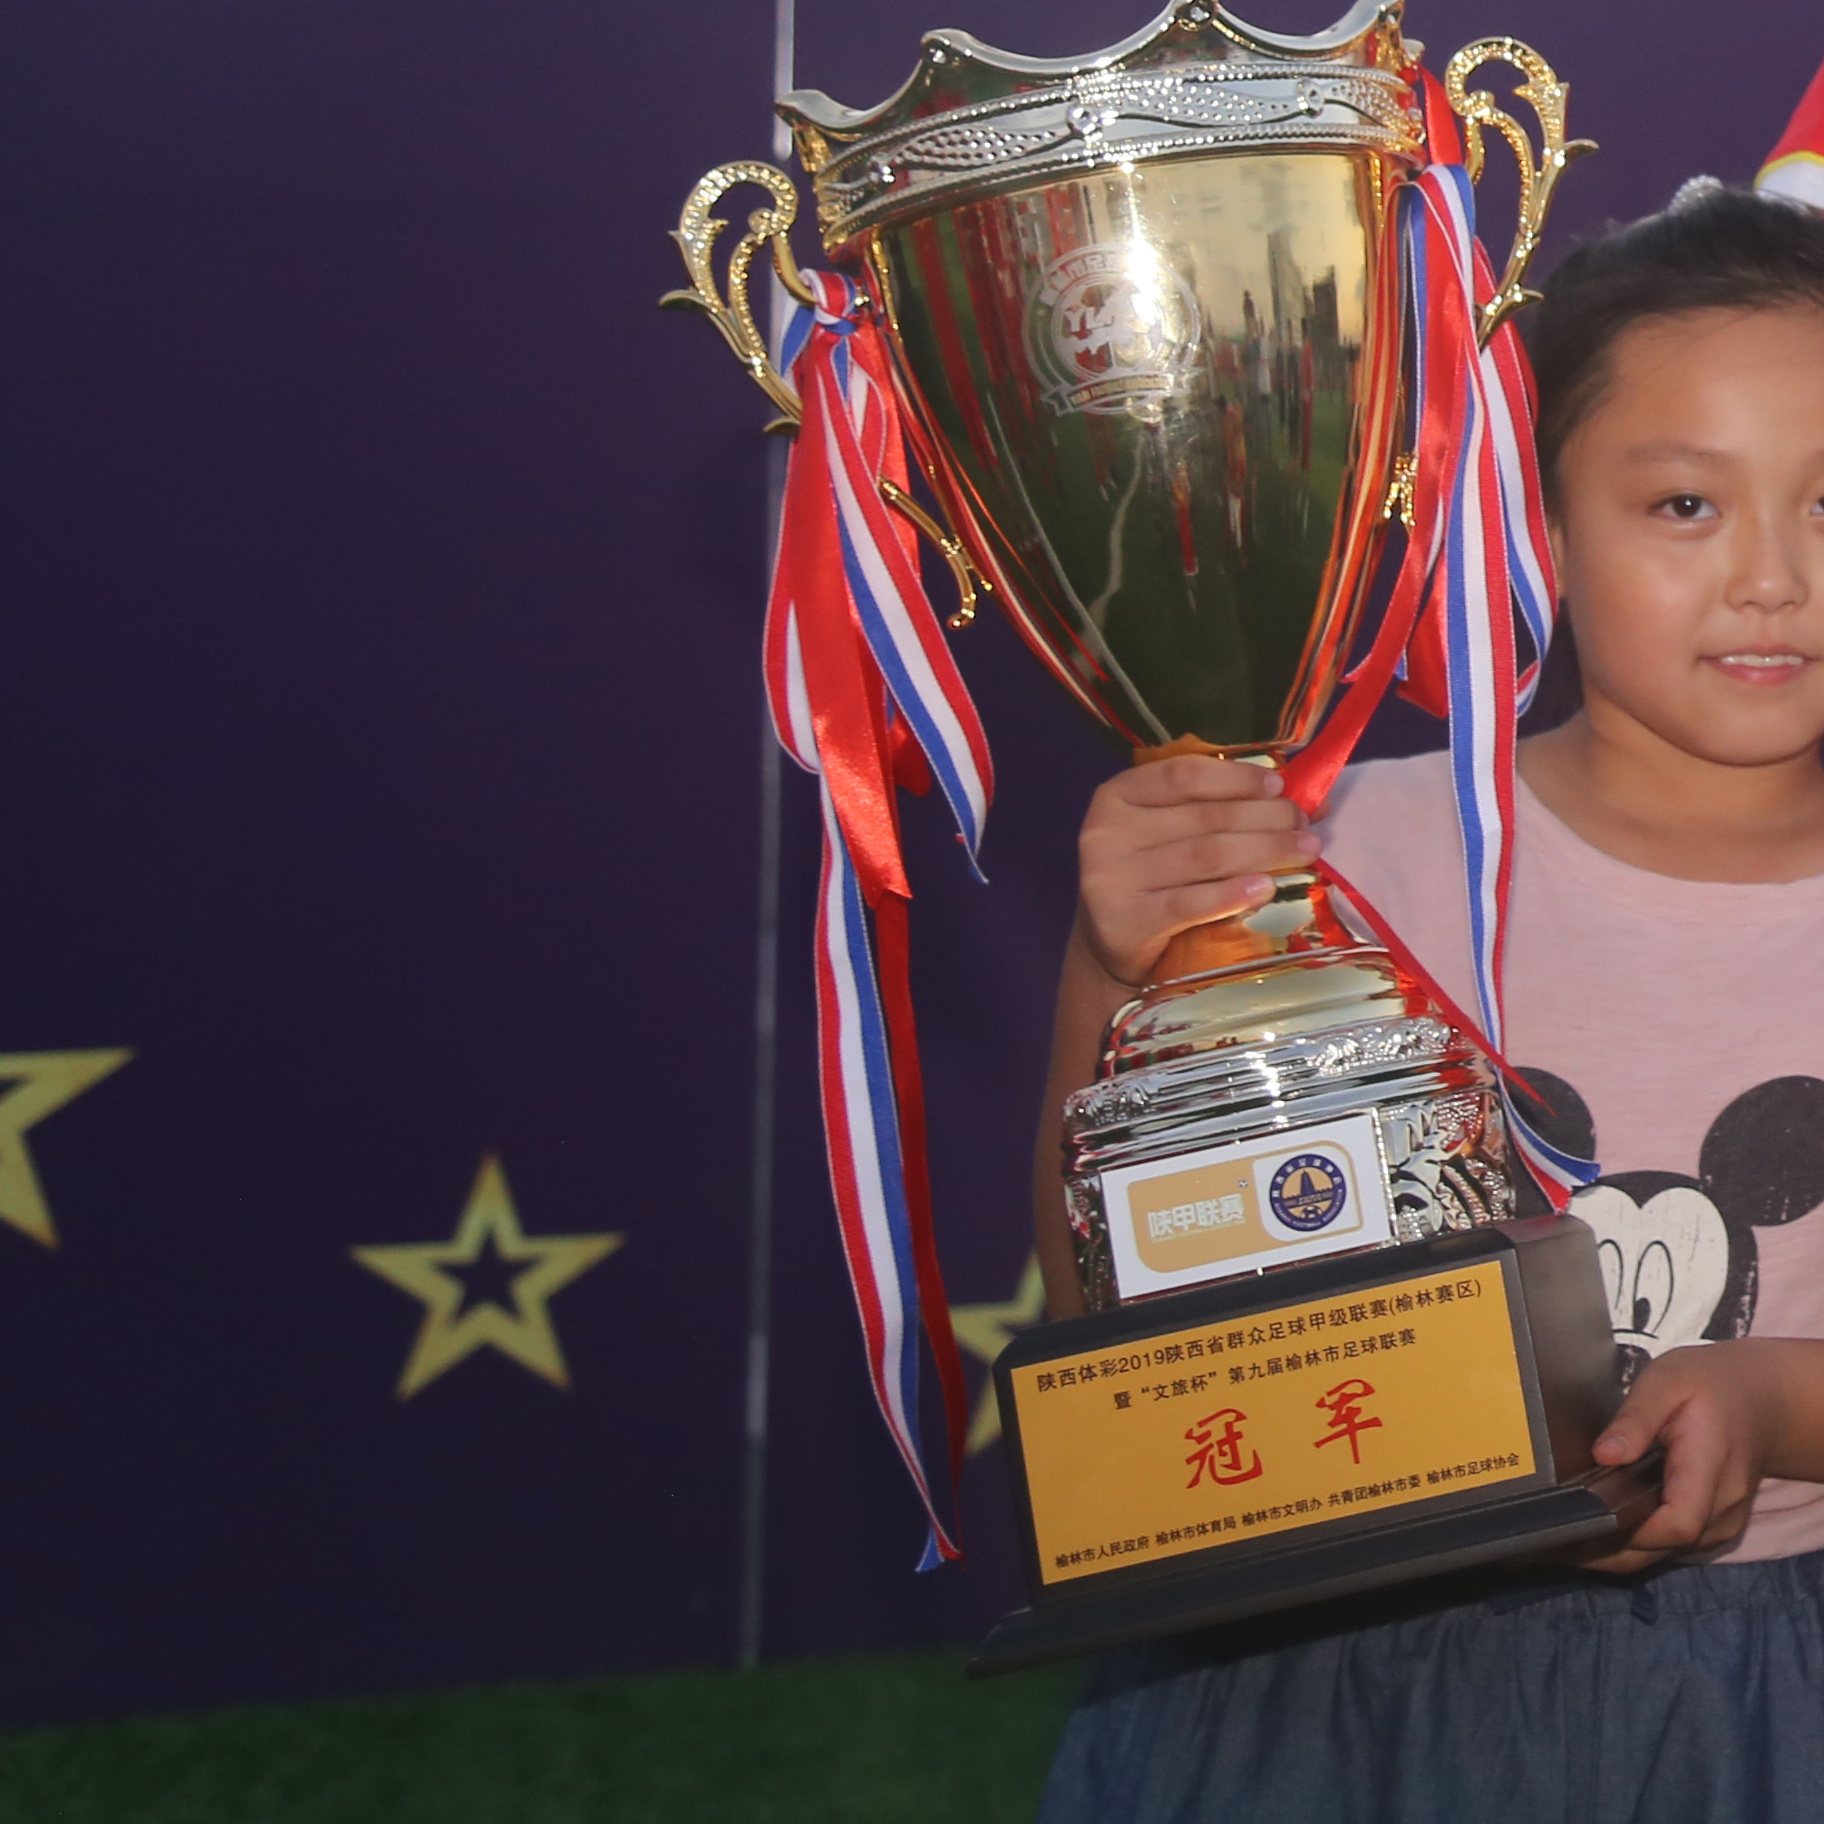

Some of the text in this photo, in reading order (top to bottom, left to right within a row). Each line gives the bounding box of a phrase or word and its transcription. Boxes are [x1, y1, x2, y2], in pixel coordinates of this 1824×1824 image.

[1147, 1193, 1244, 1238] 陕甲联赛
[1185, 1379, 1383, 1490] 冠军
